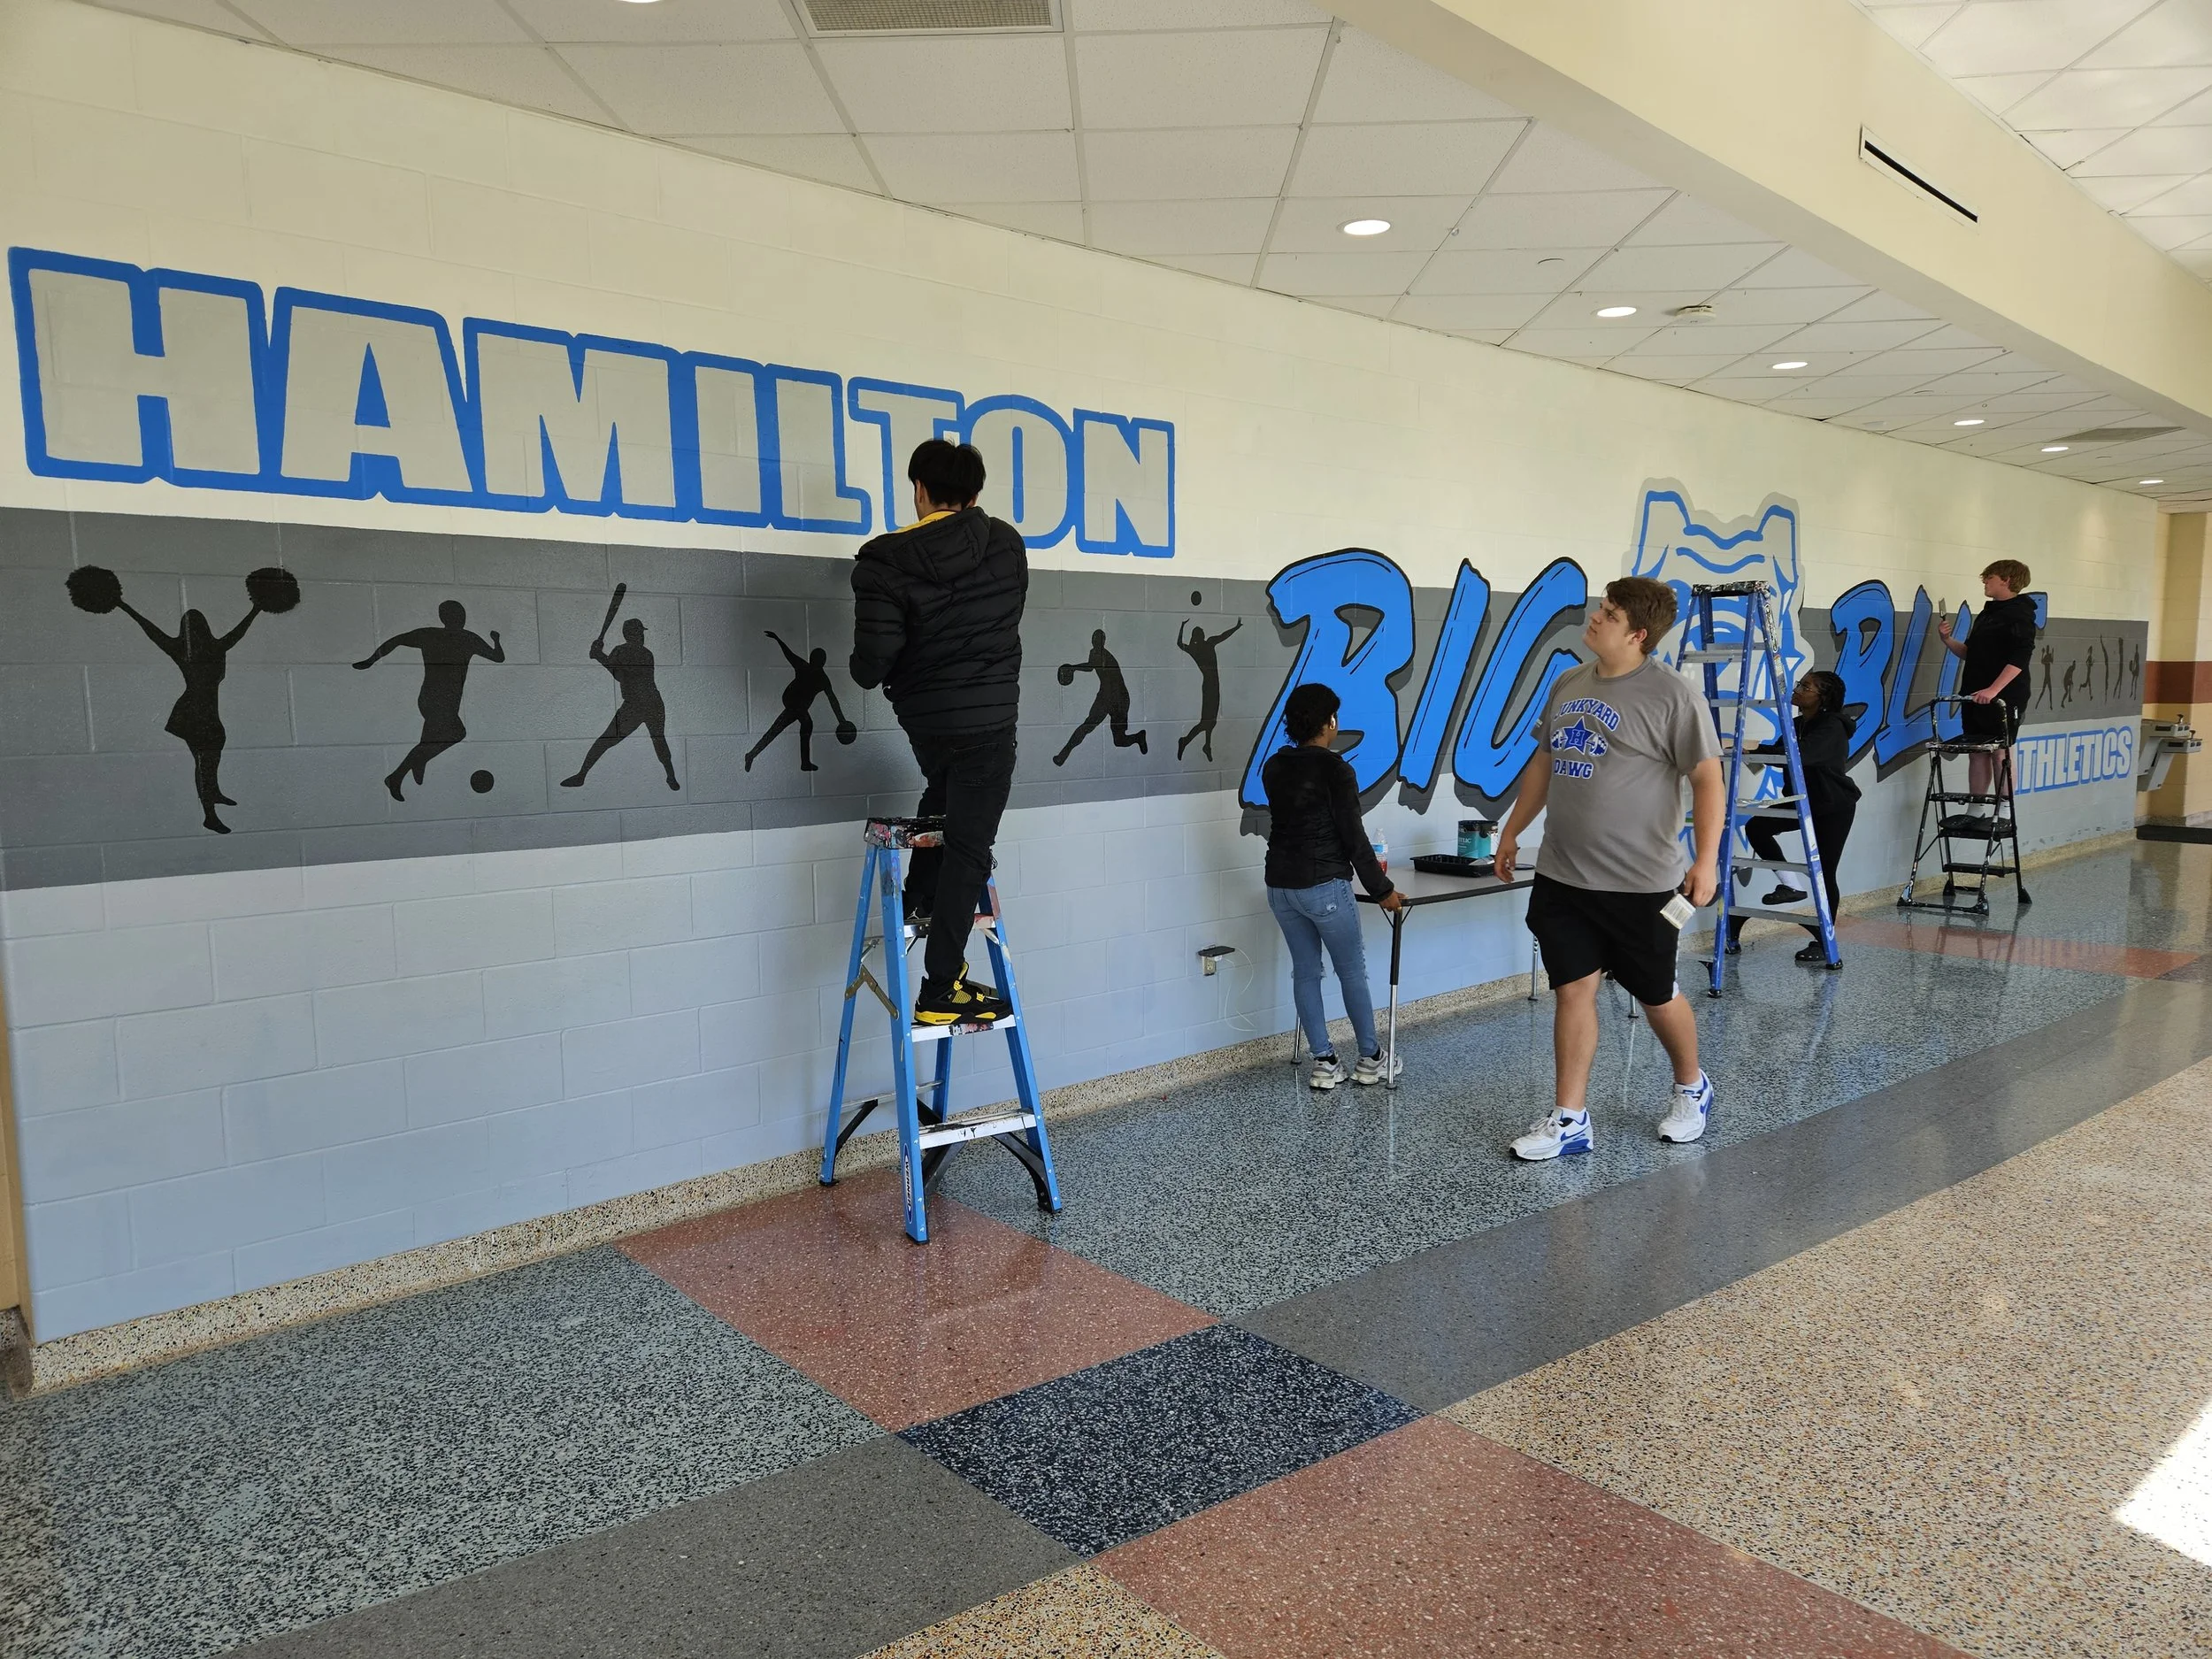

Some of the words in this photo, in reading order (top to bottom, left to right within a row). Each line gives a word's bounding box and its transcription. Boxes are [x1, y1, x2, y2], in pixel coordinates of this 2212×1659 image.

[9, 248, 1175, 558] HAMILTON
[1239, 548, 1588, 809] BIG
[1554, 758, 1594, 780] DAWG
[1571, 729, 1585, 746] H
[2015, 726, 2133, 795] THLETICS
